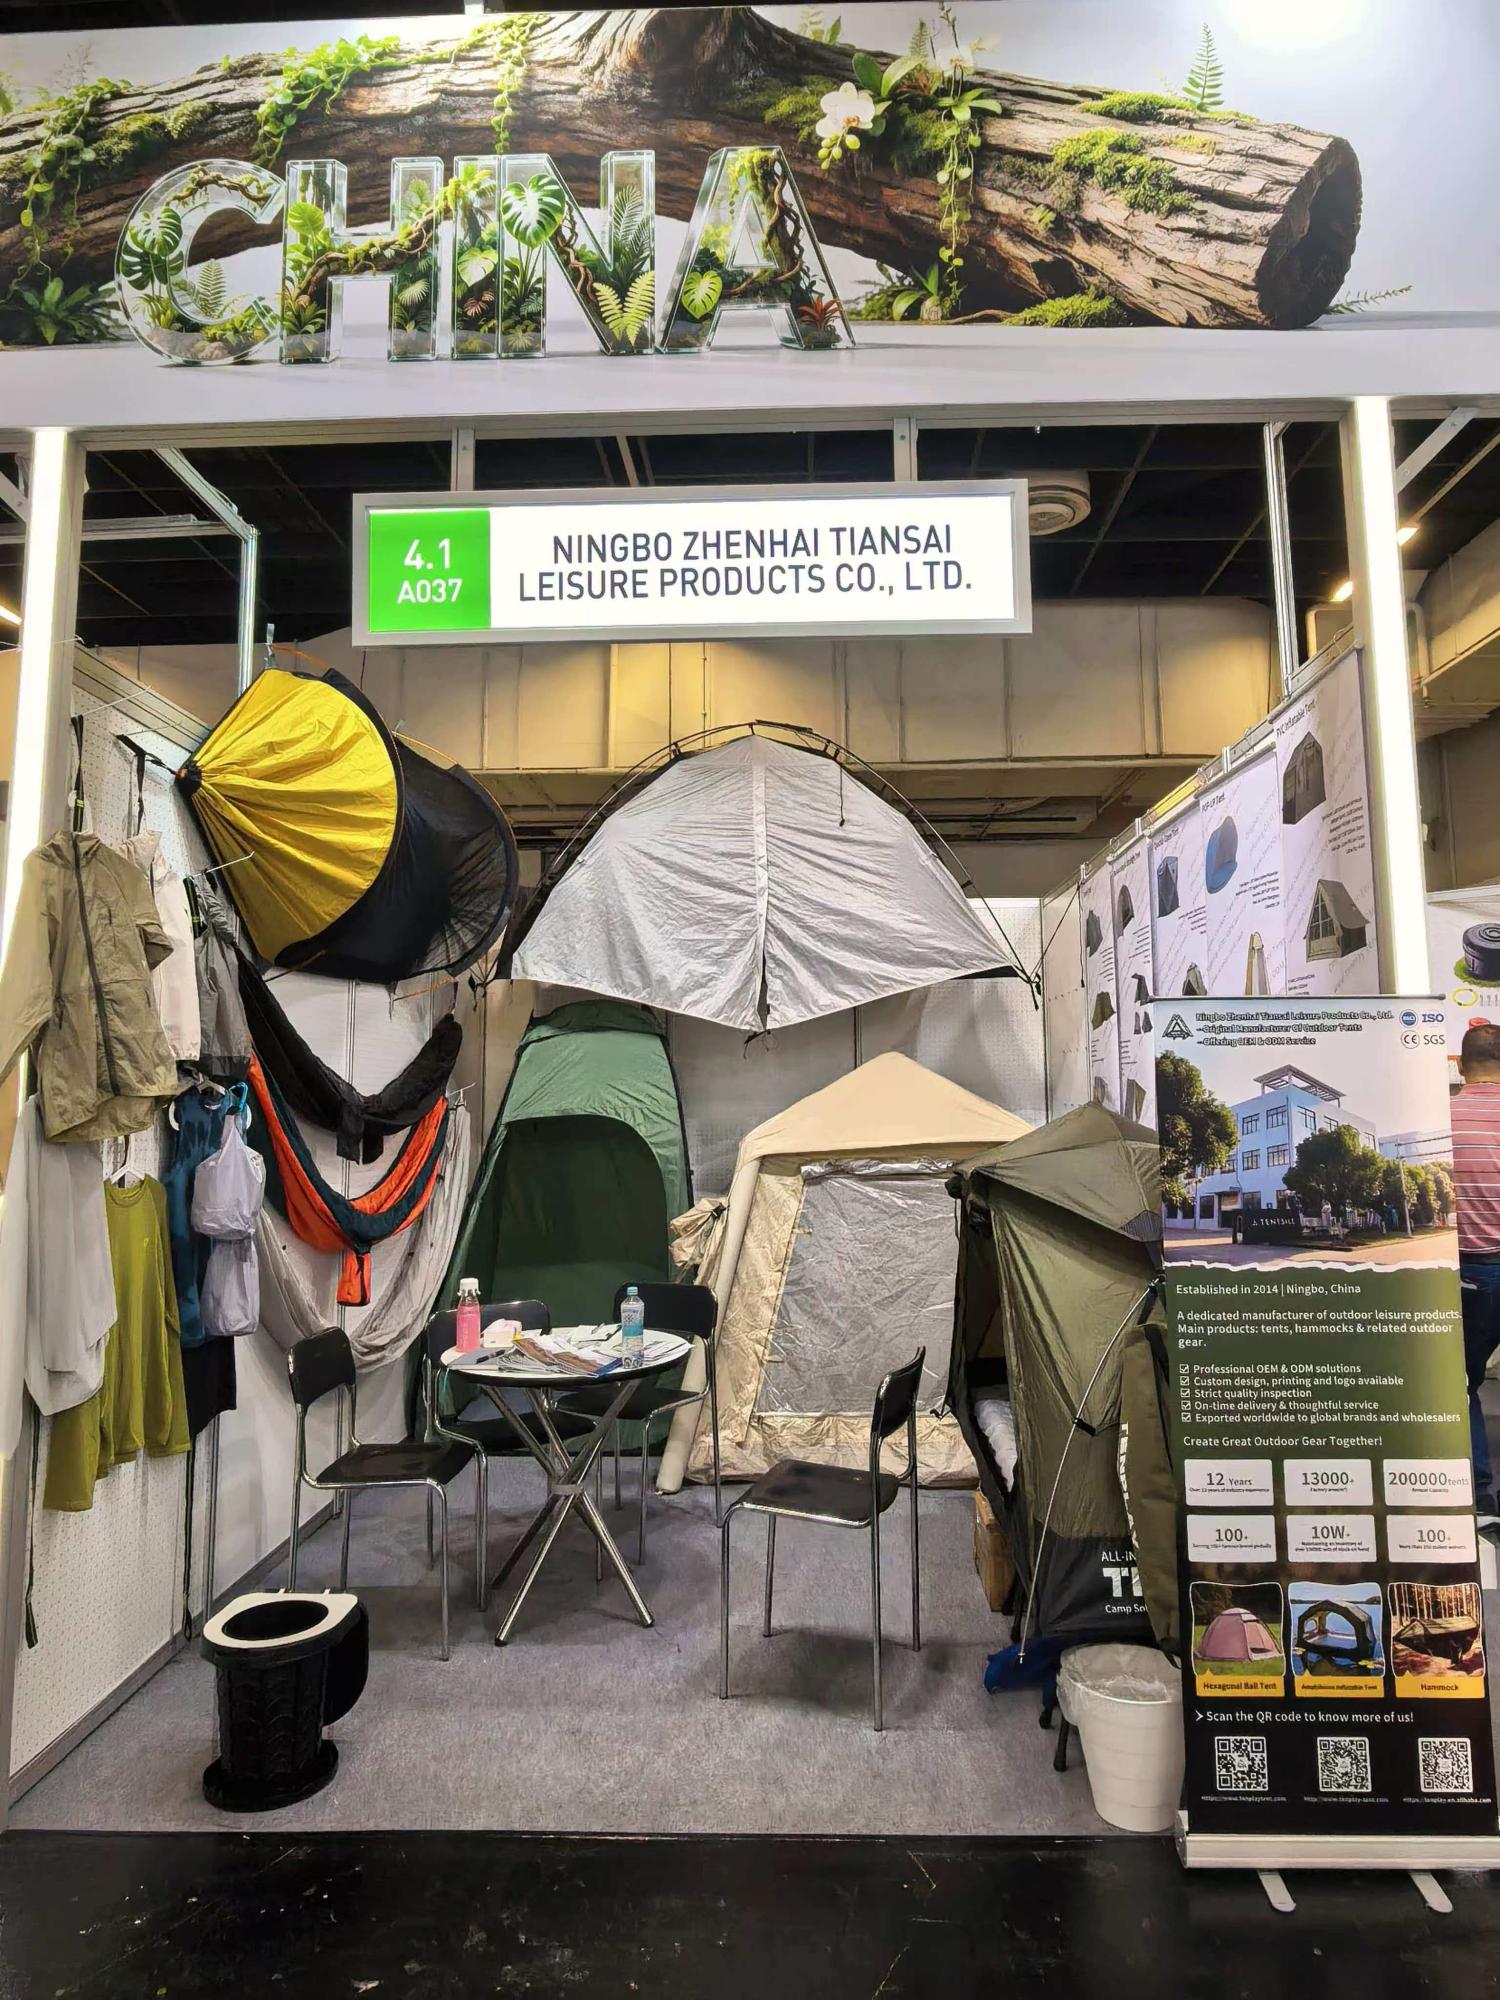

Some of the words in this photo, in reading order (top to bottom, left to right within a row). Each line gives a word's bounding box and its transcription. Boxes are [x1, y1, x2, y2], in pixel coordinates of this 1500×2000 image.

[115, 146, 857, 365] CHINA
[553, 531, 672, 565] NINGBO
[682, 527, 820, 561] ZHENHAI
[829, 523, 951, 556] TIANSAI
[404, 538, 451, 569] 4.1
[519, 568, 648, 602] LEISURE
[660, 563, 825, 597] PRODUCTS
[835, 561, 894, 596] CO.,
[905, 559, 972, 592] LTD.
[397, 578, 462, 604] A037
[1422, 1013, 1445, 1023] ISO
[1423, 1035, 1446, 1045] SGS
[1176, 1284, 1238, 1295] Established
[1241, 1284, 1251, 1294] in
[1253, 1285, 1279, 1294] 2014
[1286, 1284, 1329, 1296] Ningbo,
[1330, 1284, 1361, 1294] China
[1177, 1311, 1185, 1320] A
[1187, 1311, 1240, 1321] dedicated
[1242, 1310, 1315, 1321] manufacturer
[1316, 1310, 1328, 1320] of
[1329, 1310, 1373, 1320] outdoor
[1375, 1310, 1412, 1320] leisure
[1414, 1310, 1463, 1321] products.
[1178, 1324, 1205, 1334] Main
[1207, 1324, 1259, 1335] products:
[1261, 1324, 1293, 1335] tents,
[1295, 1323, 1354, 1333] hammocks
[1357, 1324, 1365, 1333] &
[1367, 1323, 1407, 1333] related
[1409, 1323, 1454, 1333] outdoor
[1178, 1338, 1207, 1349] gear.
[1193, 1364, 1255, 1374] Professional
[1256, 1364, 1279, 1374] OEM
[1280, 1364, 1288, 1374] &
[1290, 1364, 1314, 1374] ODM
[1316, 1363, 1361, 1373] solutions
[1193, 1376, 1232, 1386] Custom
[1234, 1376, 1270, 1388] design,
[1271, 1376, 1312, 1388] printing
[1313, 1376, 1332, 1386] and
[1333, 1376, 1356, 1387] logo
[1358, 1376, 1404, 1386] available
[1194, 1388, 1221, 1398] Strict
[1224, 1388, 1259, 1400] quality
[1260, 1388, 1312, 1400] inspection
[1194, 1401, 1235, 1411] On-time
[1237, 1400, 1277, 1412] delivery
[1279, 1401, 1287, 1410] &
[1288, 1400, 1342, 1412] thoughtful
[1344, 1401, 1379, 1410] service
[1195, 1413, 1241, 1424] Exported
[1242, 1412, 1295, 1423] worldwide
[1297, 1413, 1308, 1423] to
[1310, 1412, 1341, 1424] global
[1343, 1412, 1378, 1423] brands
[1380, 1412, 1400, 1422] and
[1401, 1412, 1461, 1423] wholesalers
[1183, 1436, 1220, 1447] Create
[1222, 1436, 1252, 1446] Great
[1254, 1436, 1299, 1446] Outdoor
[1302, 1436, 1327, 1446] Gear
[1329, 1436, 1383, 1448] Together!
[1206, 1472, 1225, 1486] 12
[1228, 1478, 1252, 1486] Years
[1105, 1604, 1132, 1615] Camp
[1203, 1682, 1242, 1691] Hexagonal
[1243, 1682, 1259, 1690] Ball
[1260, 1682, 1277, 1690] Tent
[1421, 1683, 1459, 1691] Hammock
[1206, 1711, 1233, 1722] Scan
[1235, 1711, 1254, 1722] the
[1256, 1711, 1272, 1723] QR
[1275, 1711, 1301, 1722] code
[1304, 1712, 1316, 1722] to
[1318, 1711, 1349, 1722] know
[1351, 1713, 1381, 1722] more
[1383, 1711, 1395, 1722] of
[1397, 1711, 1414, 1722] us!
